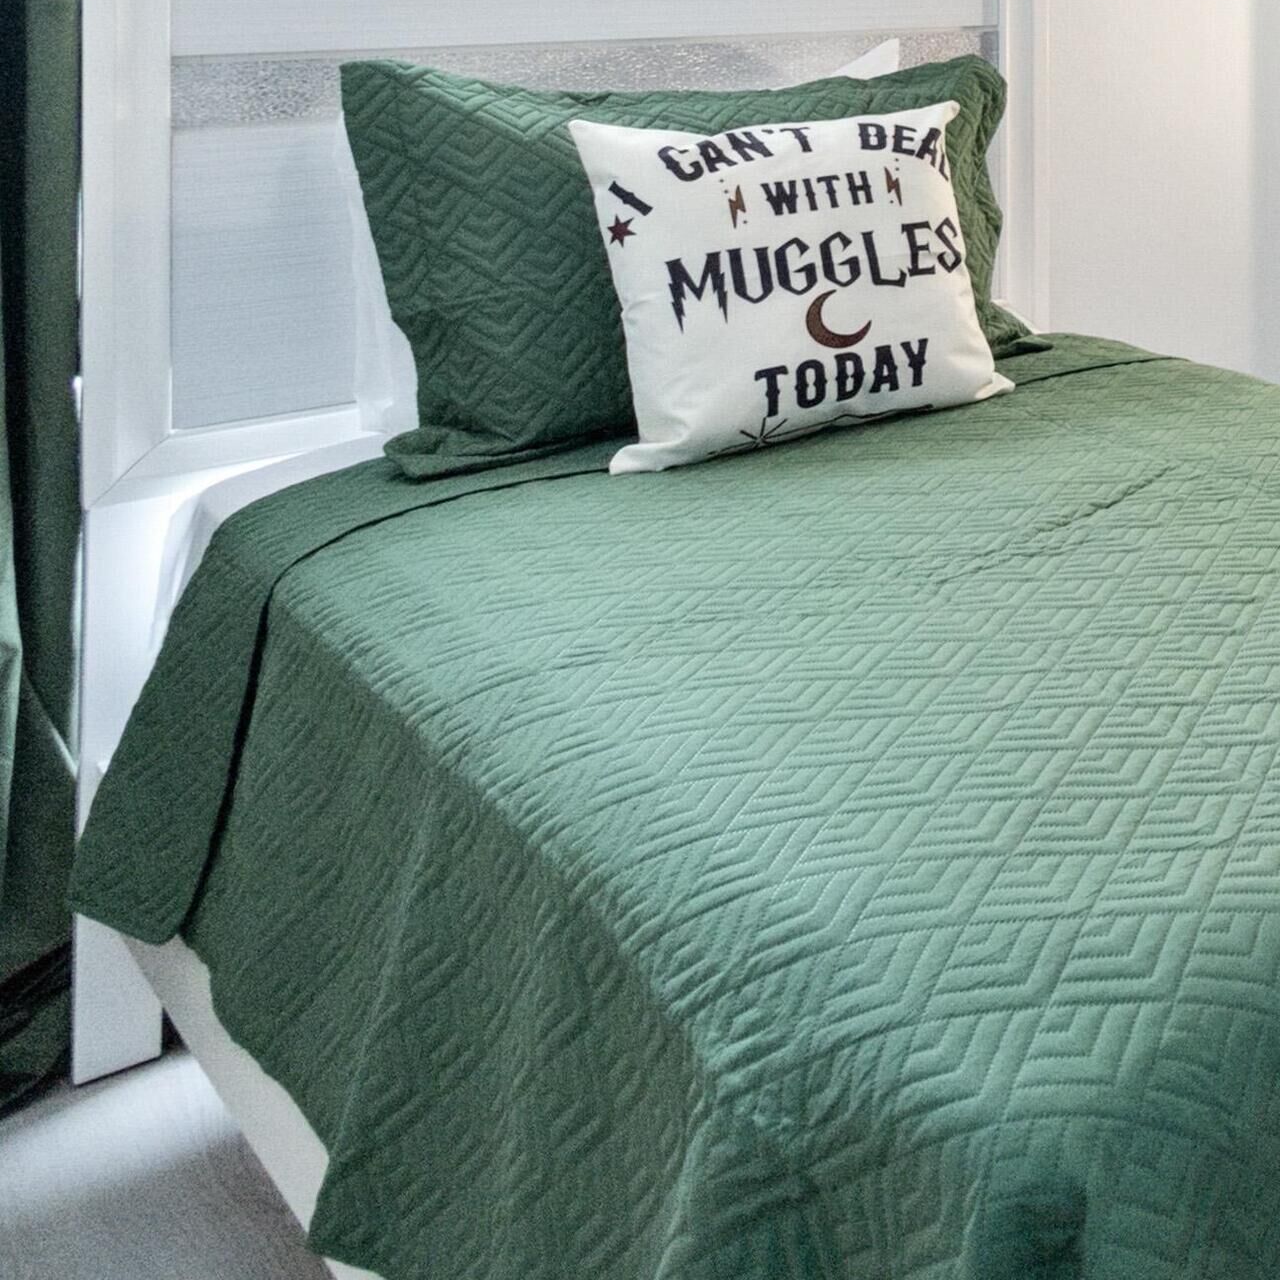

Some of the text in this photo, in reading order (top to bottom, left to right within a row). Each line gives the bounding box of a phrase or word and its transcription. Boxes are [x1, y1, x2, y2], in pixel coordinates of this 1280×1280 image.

[608, 180, 654, 216] I
[658, 126, 811, 182] CAN'T
[761, 171, 874, 215] WITH
[665, 217, 962, 333] MUGGLES
[754, 338, 929, 417] TODAY
